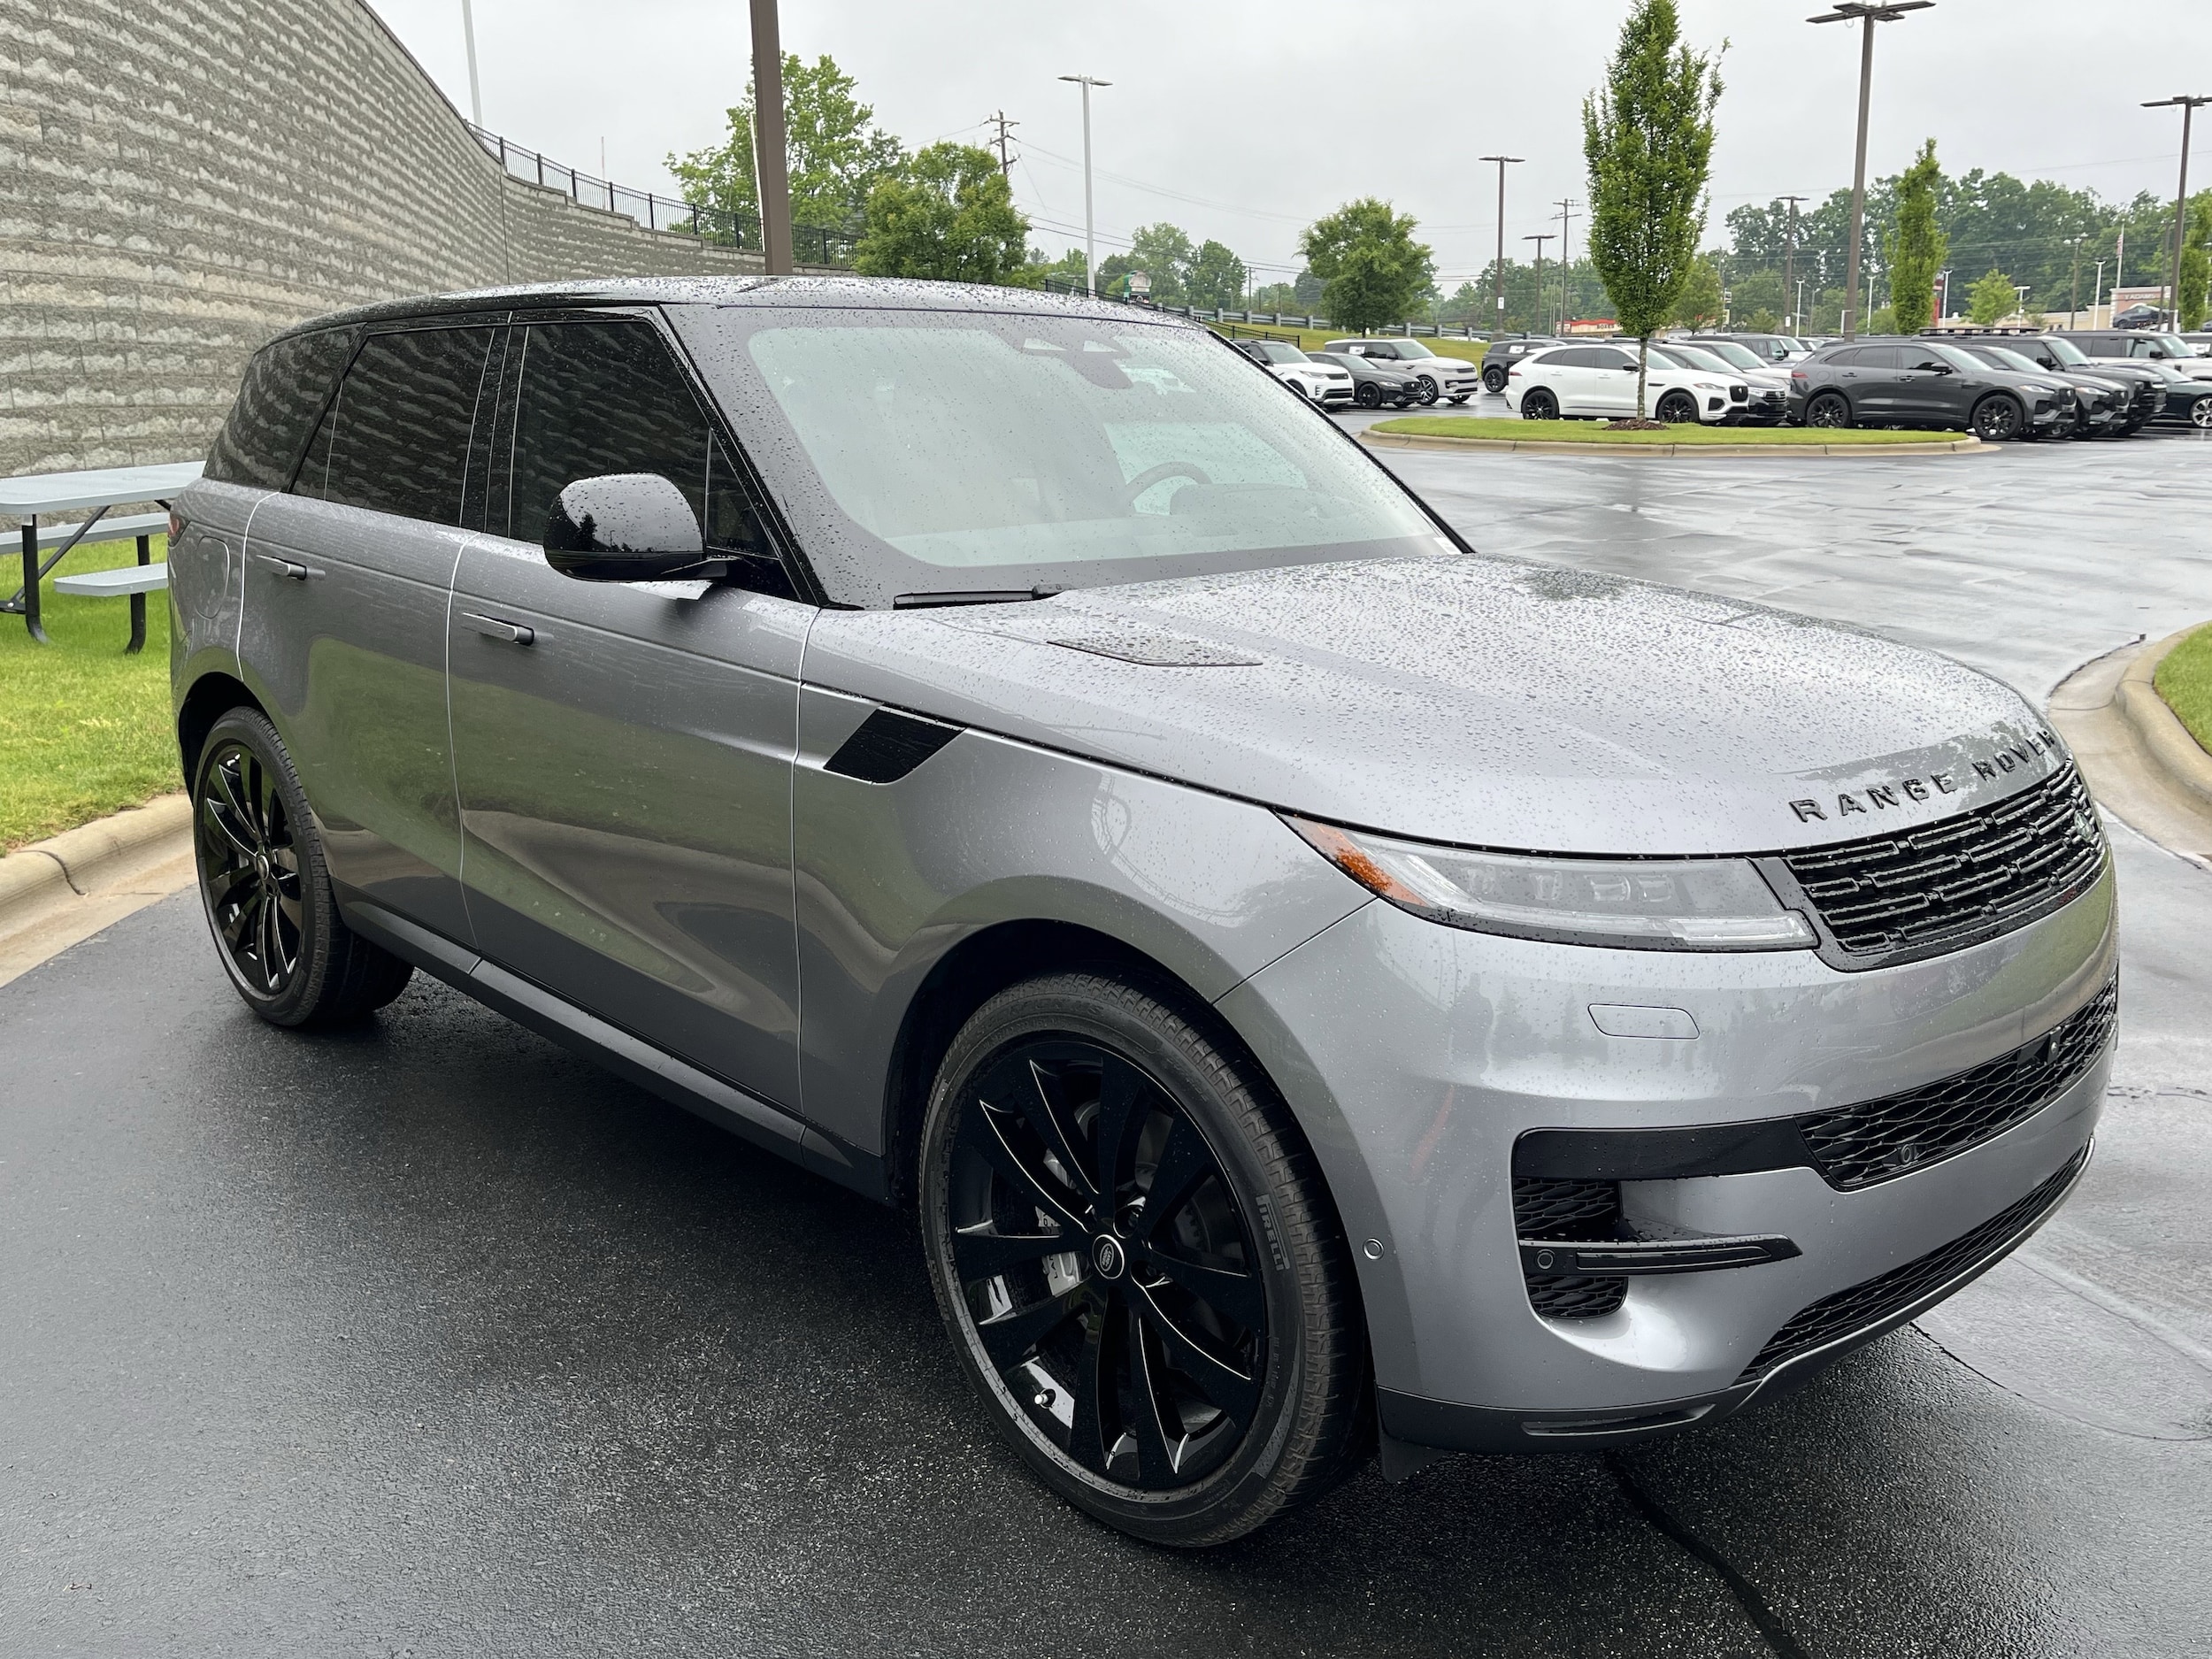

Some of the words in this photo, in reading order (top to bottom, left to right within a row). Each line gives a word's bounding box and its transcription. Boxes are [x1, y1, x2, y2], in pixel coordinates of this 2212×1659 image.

[1788, 772, 1958, 823] RANGE
[1971, 727, 2055, 781] ROVER
[1256, 1194, 1290, 1271] PIRELLI
